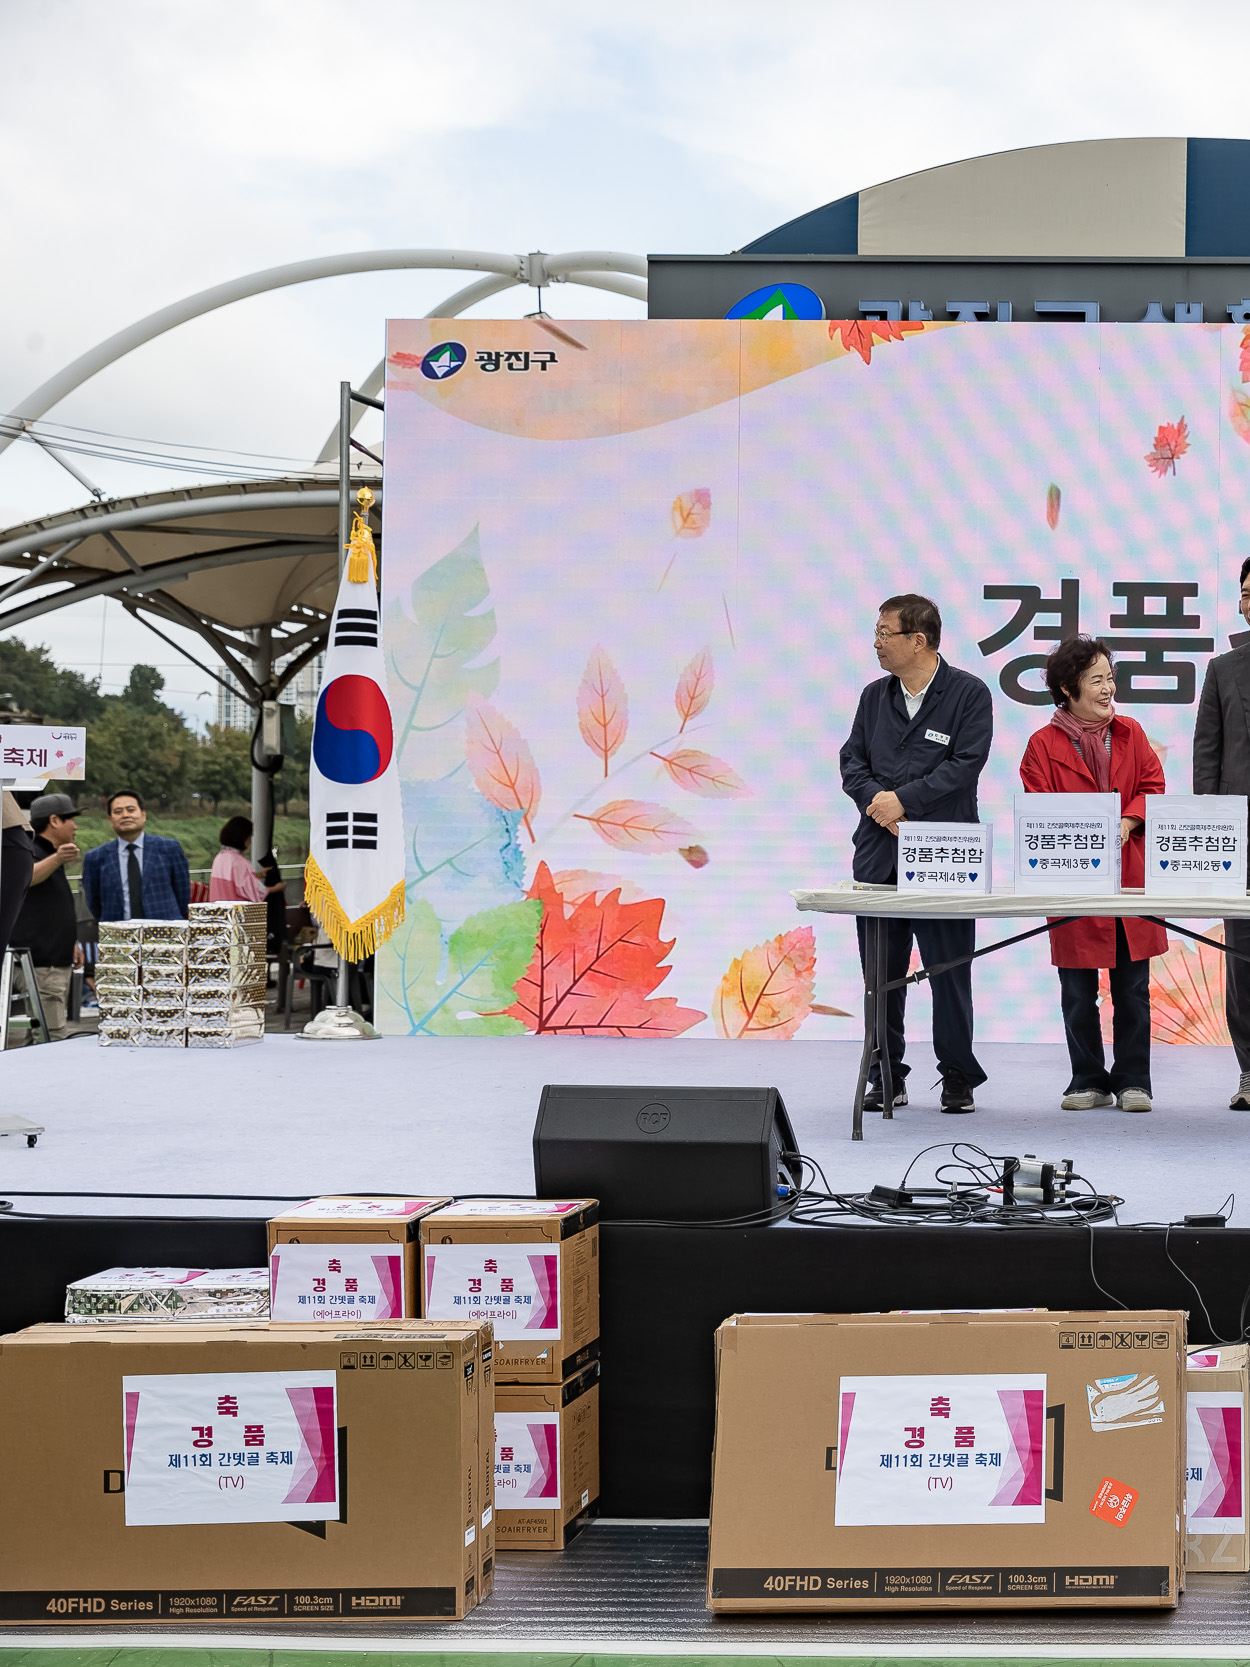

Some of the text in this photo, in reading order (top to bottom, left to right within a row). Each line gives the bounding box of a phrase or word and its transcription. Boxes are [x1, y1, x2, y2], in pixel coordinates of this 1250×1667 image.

[474, 351, 558, 372] 광진구
[4, 748, 47, 767] 축제
[1024, 834, 1106, 850] 경품추첨함
[1156, 836, 1237, 852] 경품추첨함
[902, 847, 984, 863] 경품추첨함
[1039, 859, 1090, 869] 중곡제3동
[1171, 860, 1221, 871] 중곡제2동
[916, 872, 967, 883] 중곡제4동
[640, 1112, 669, 1125] RCF
[328, 1259, 341, 1273] 축
[484, 1259, 498, 1273] 축
[312, 1278, 358, 1292] 경 품
[468, 1278, 514, 1293] 경 품
[298, 1295, 326, 1304] 제11회
[358, 1295, 376, 1304] 축제
[453, 1295, 481, 1305] 제11회
[514, 1295, 532, 1305] 축제
[312, 1310, 362, 1319] (에어프라이)
[468, 1310, 517, 1320] (에어프라이)
[217, 1395, 239, 1417] 축
[929, 1396, 951, 1418] 축
[191, 1424, 265, 1448] 경 품
[904, 1426, 976, 1449] 경 품
[168, 1451, 293, 1468] 제11회 간뎃골 축제
[500, 1447, 514, 1461] 품
[879, 1452, 1002, 1468] 제11회 간뎃골 축제
[514, 1464, 532, 1473] 축제
[218, 1475, 245, 1490] (TV)
[927, 1476, 953, 1491] (TV)
[1114, 1493, 1133, 1521] 취급주의
[763, 1576, 869, 1591] 40FHD Series
[884, 1575, 932, 1584] 1920x1080
[947, 1575, 995, 1584] FAST
[1008, 1575, 1047, 1583] 100.3cm
[1065, 1575, 1115, 1586] HDMI
[884, 1585, 900, 1594] High
[46, 1598, 153, 1613] 40FHD Series
[169, 1597, 217, 1606] 1920x1080
[233, 1596, 280, 1605] FAST
[294, 1596, 333, 1604] 100.3cm
[352, 1596, 401, 1606] HDMI
[169, 1607, 184, 1615] High
